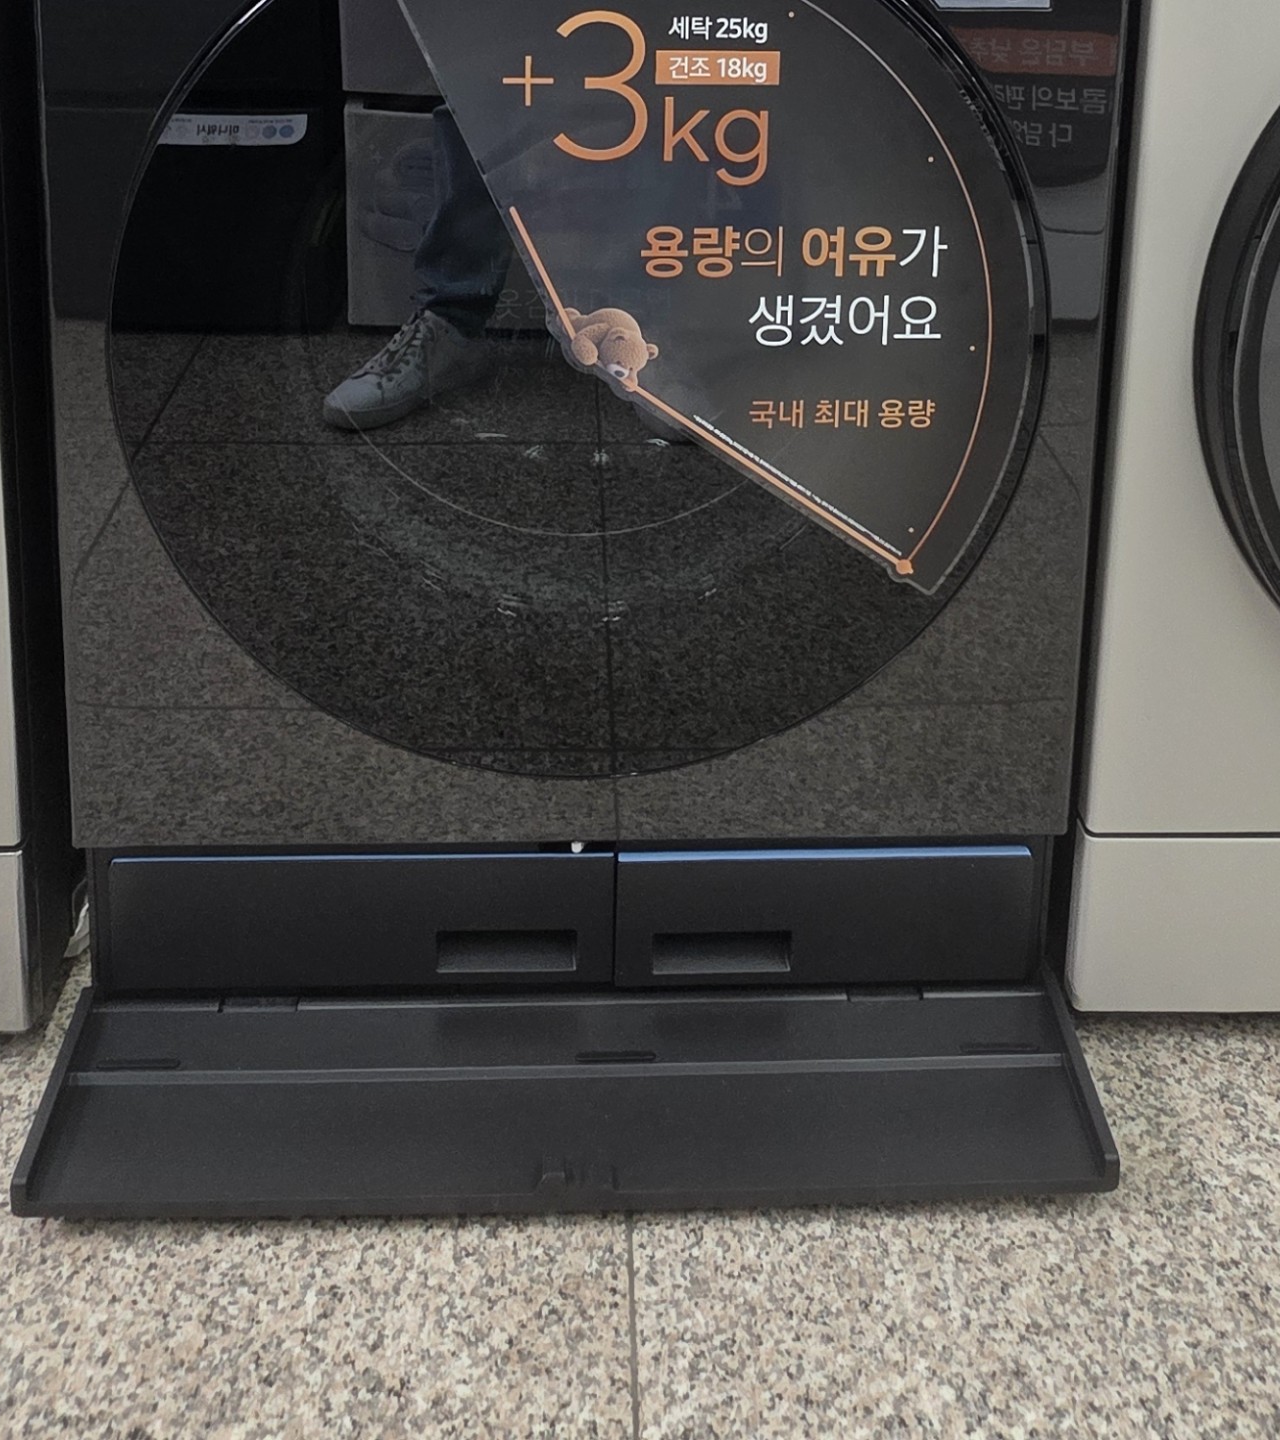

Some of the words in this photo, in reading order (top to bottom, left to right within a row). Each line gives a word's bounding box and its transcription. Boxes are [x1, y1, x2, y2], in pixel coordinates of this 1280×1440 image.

[668, 16, 712, 41] 세탁
[715, 17, 769, 44] 25kg
[669, 57, 711, 79] 건조
[717, 57, 768, 83] 18kg
[640, 225, 784, 278] 용량의
[802, 225, 948, 278] 여유가
[748, 293, 942, 347] 생겼어요
[749, 399, 804, 428] 국내
[814, 399, 869, 428] 최대
[877, 399, 936, 429] 용량
